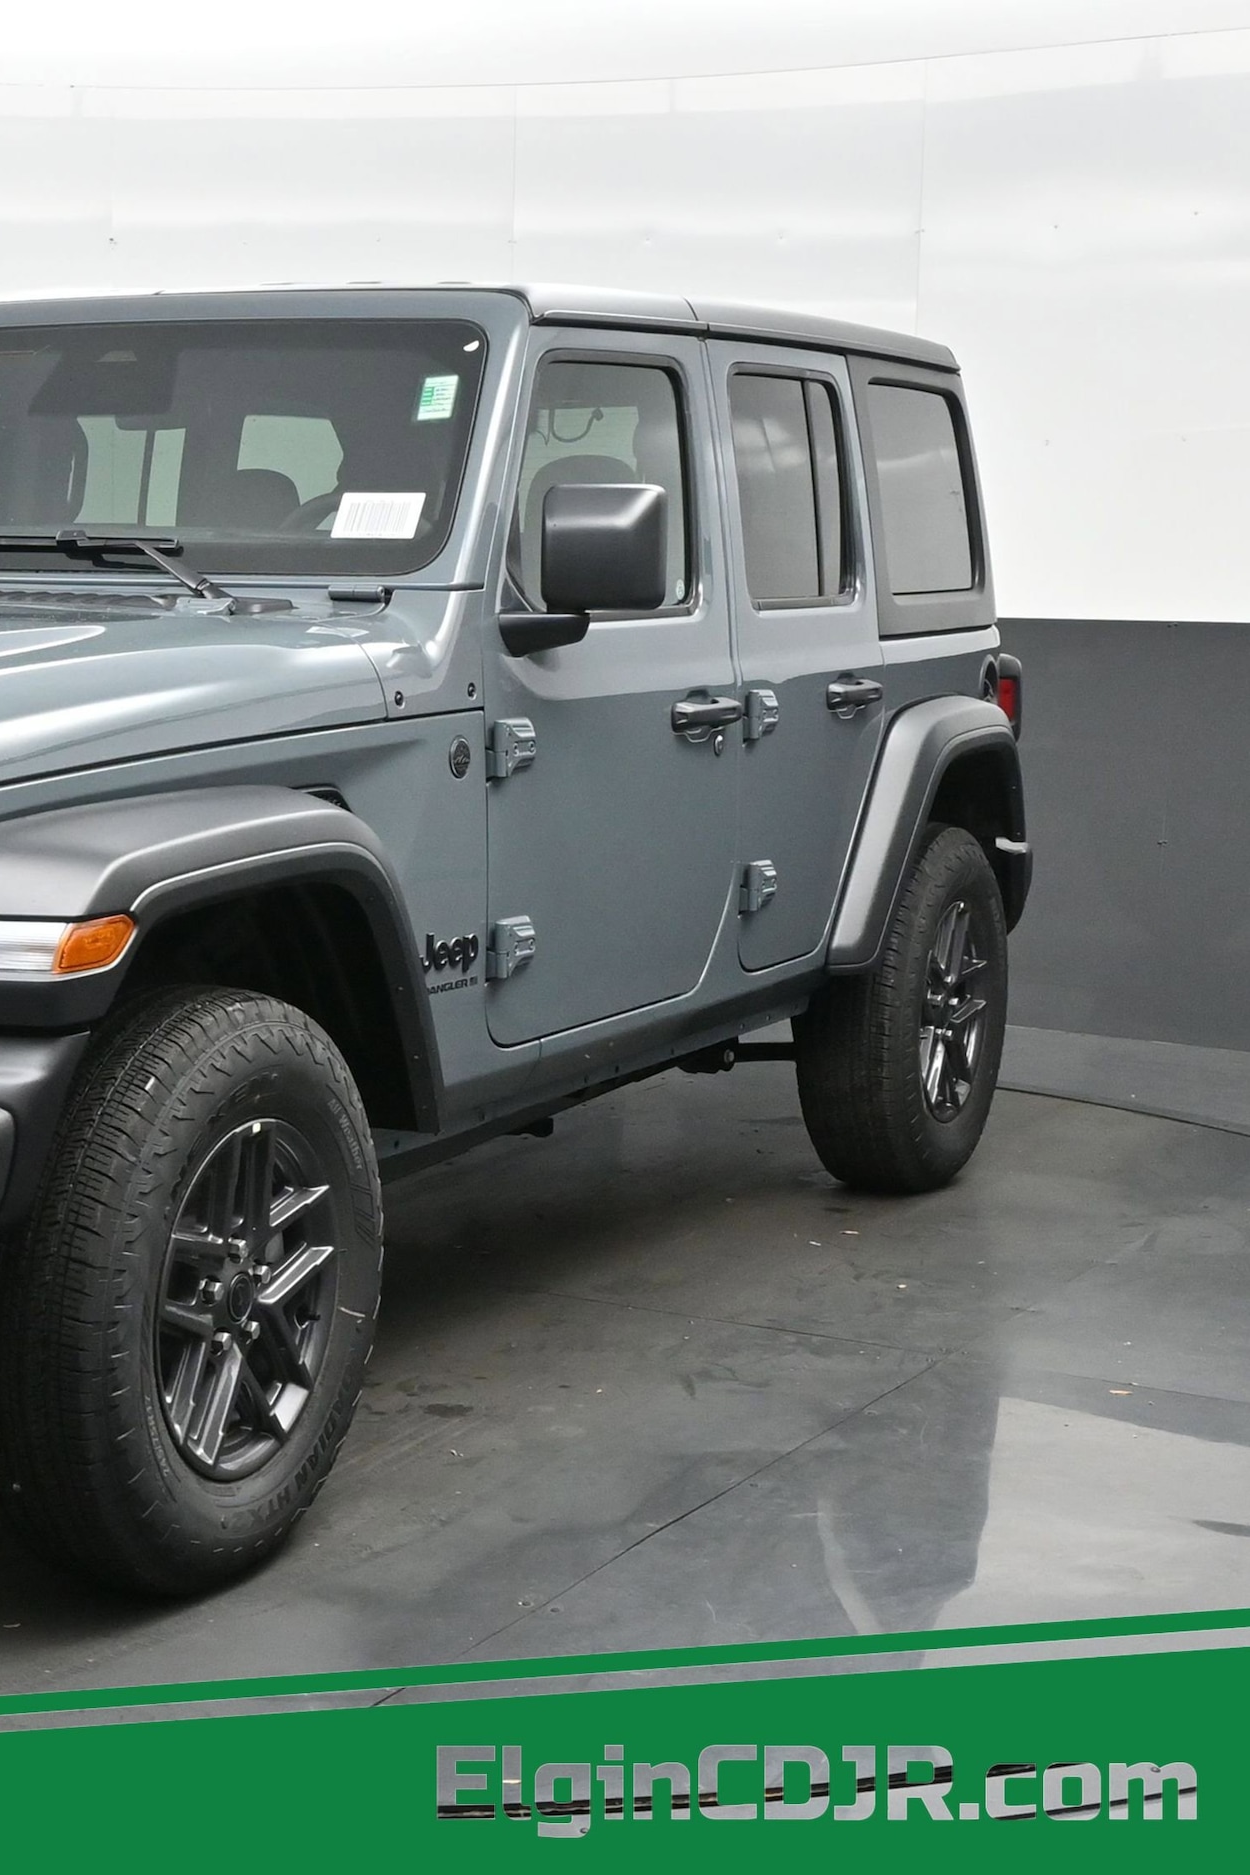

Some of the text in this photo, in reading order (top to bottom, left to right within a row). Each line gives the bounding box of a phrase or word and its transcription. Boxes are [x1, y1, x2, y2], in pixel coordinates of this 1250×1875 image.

[419, 932, 479, 974] Jeep
[427, 979, 468, 995] ANGLER
[338, 1118, 363, 1170] Weather
